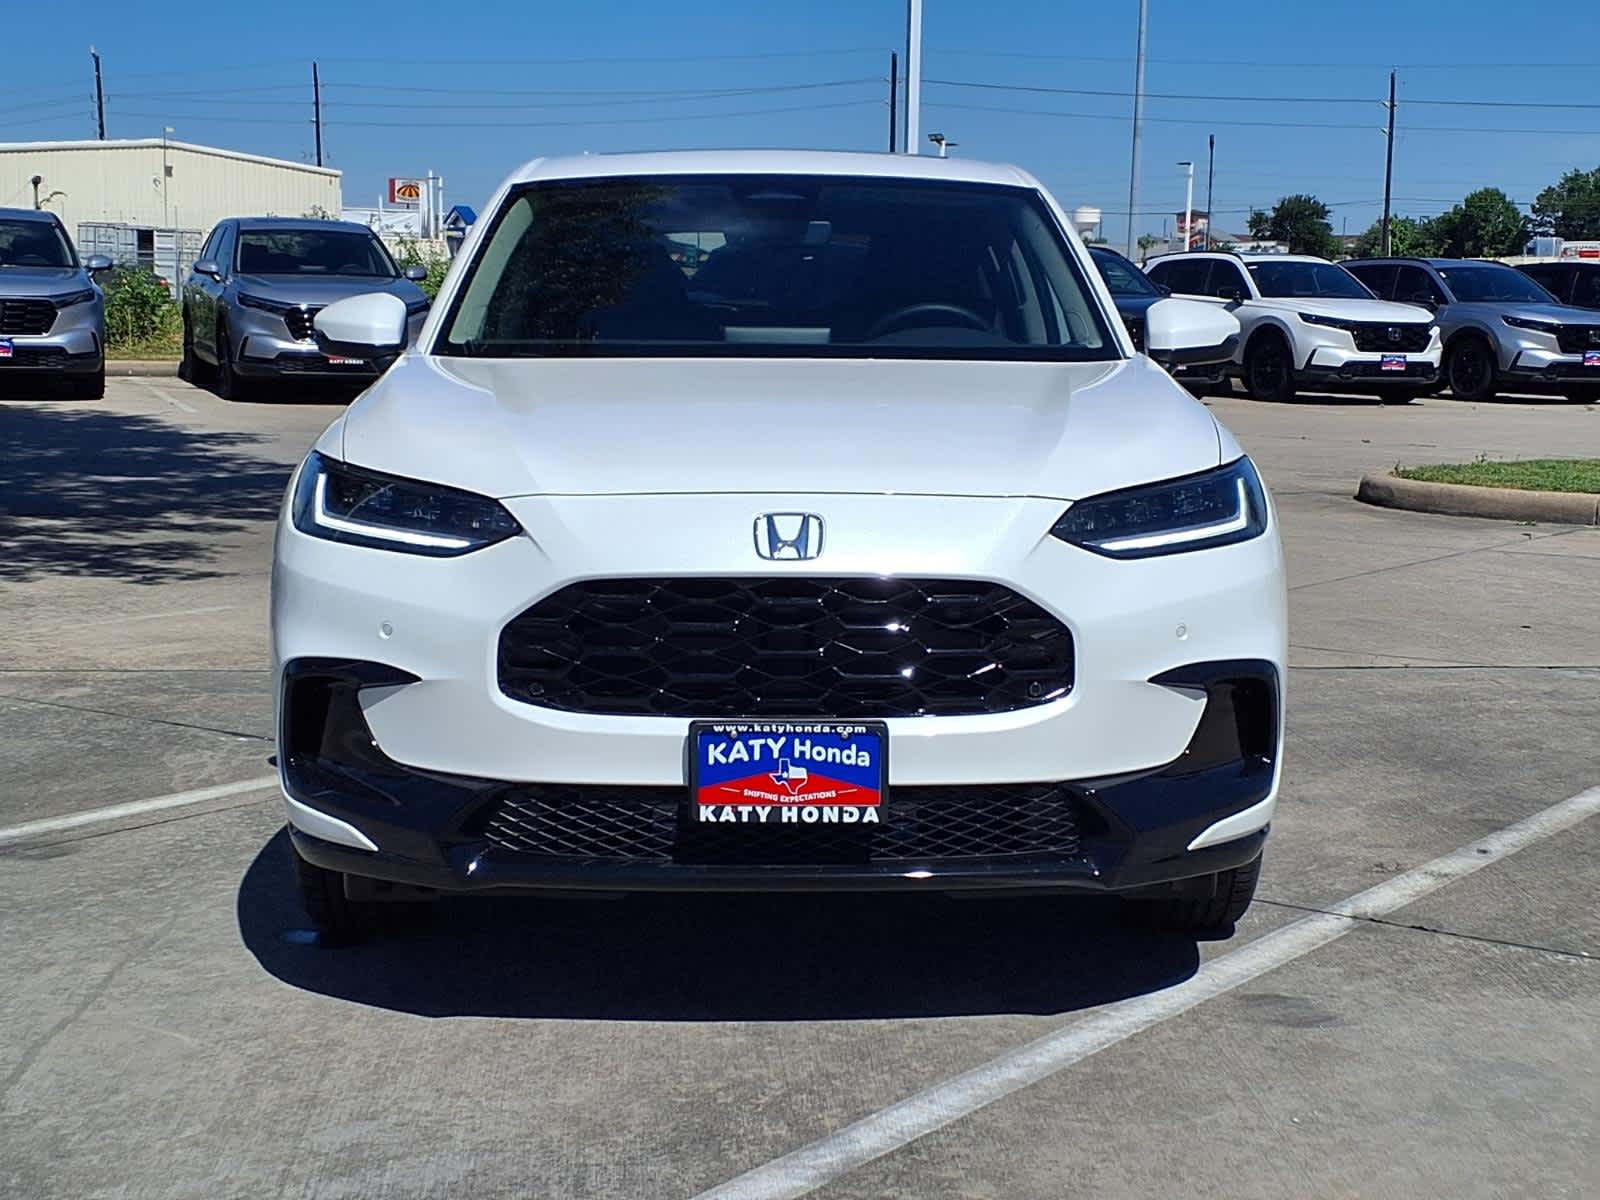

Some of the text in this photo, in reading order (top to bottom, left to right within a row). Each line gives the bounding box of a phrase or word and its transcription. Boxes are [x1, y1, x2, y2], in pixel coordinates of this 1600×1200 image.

[713, 724, 867, 734] www.katyhonda.com
[707, 736, 871, 768] KATY Honda
[743, 788, 836, 803] SHIFTING EXPECTATIONS
[699, 805, 880, 824] KATY HONDA
